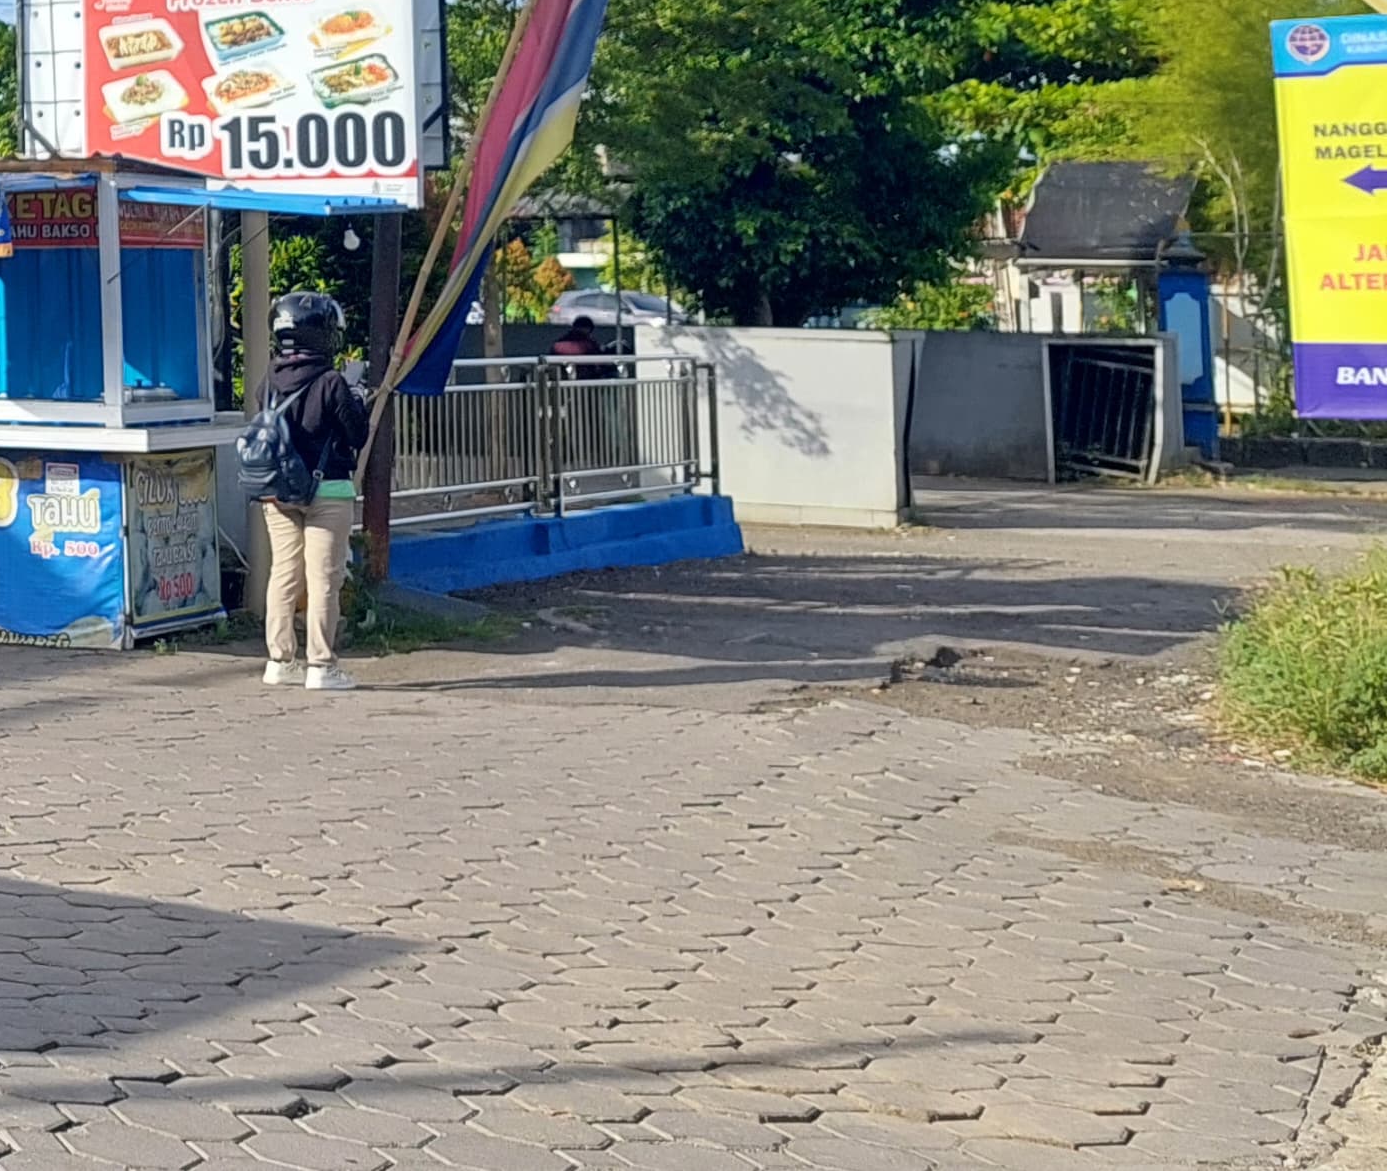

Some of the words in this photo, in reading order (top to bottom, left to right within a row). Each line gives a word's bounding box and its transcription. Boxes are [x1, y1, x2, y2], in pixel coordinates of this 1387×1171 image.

[168, 119, 205, 151] Rp
[219, 111, 406, 170] 15.000
[42, 224, 90, 238] BAKSO
[31, 540, 58, 558] Rp.
[64, 541, 99, 557] 500
[174, 572, 194, 598] 500
